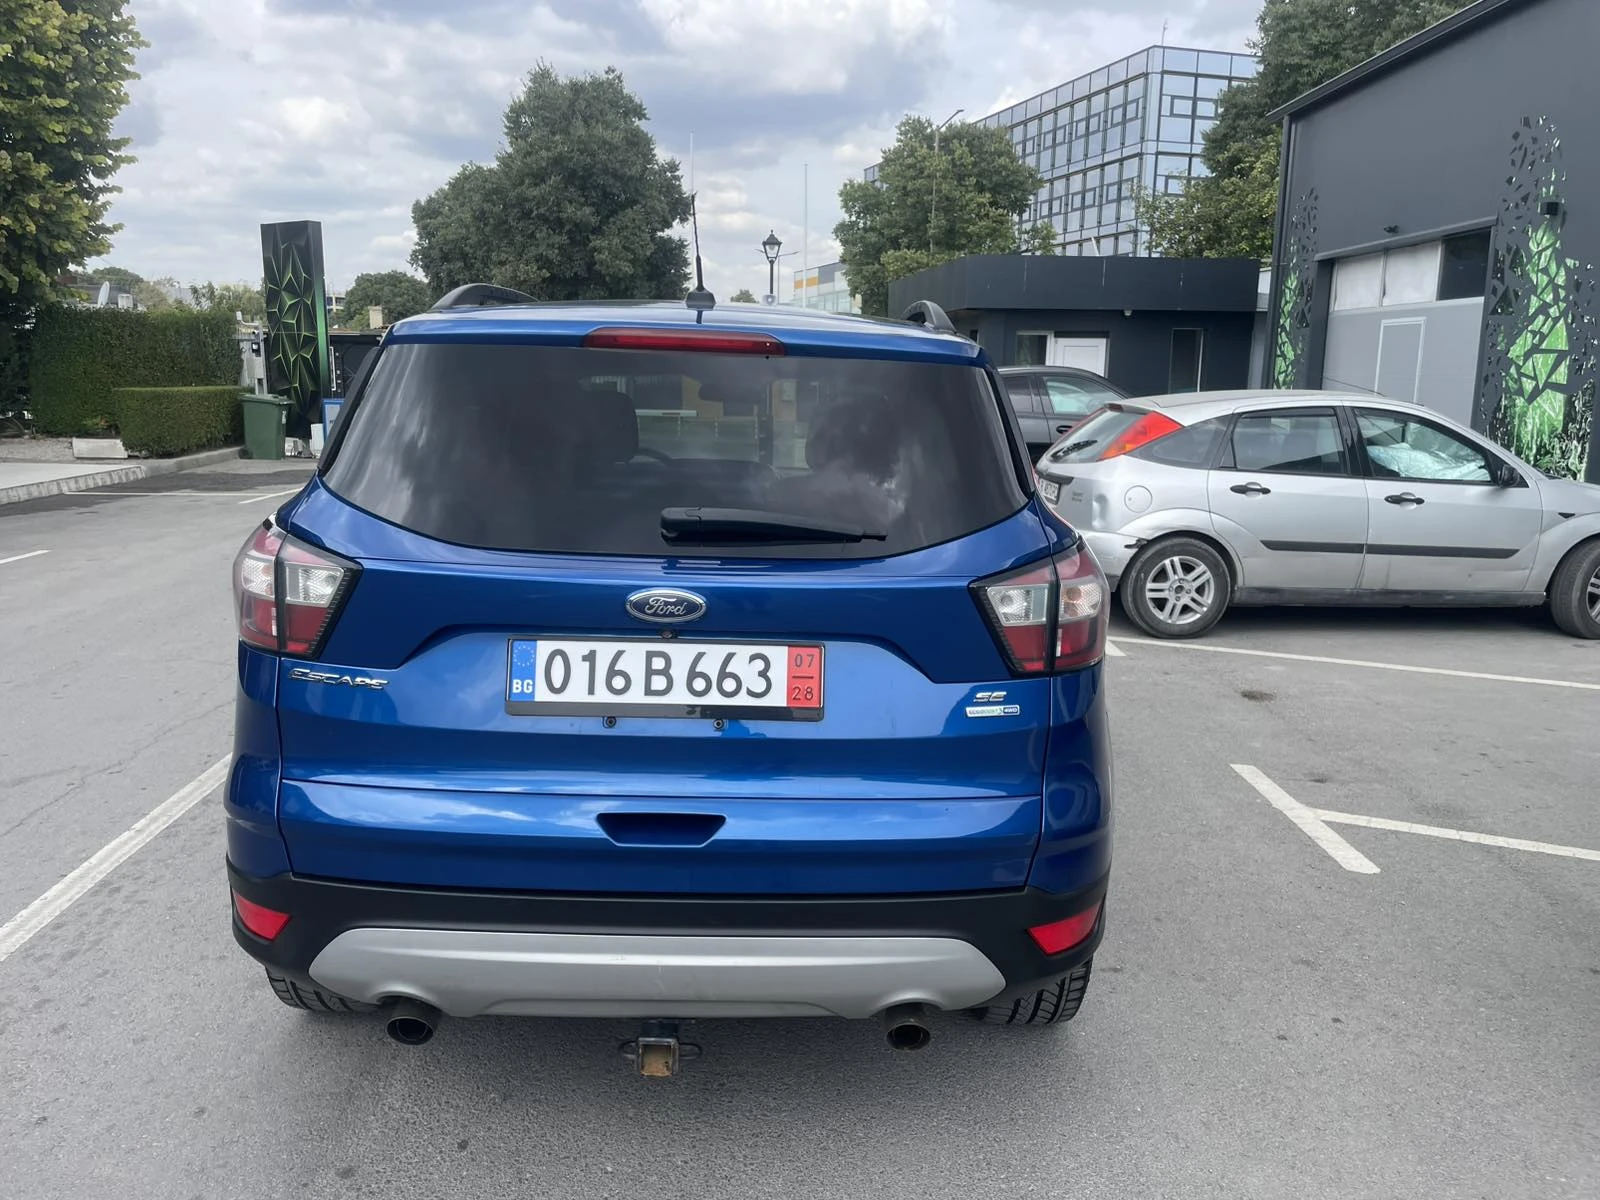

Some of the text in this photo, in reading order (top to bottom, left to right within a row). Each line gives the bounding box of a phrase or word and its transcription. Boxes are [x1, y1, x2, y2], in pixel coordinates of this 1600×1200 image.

[644, 596, 688, 615] Ford
[794, 653, 815, 668] 07
[288, 667, 389, 690] ESCAPE
[512, 679, 534, 693] BG
[792, 686, 814, 701] 28
[973, 691, 1008, 703] SE
